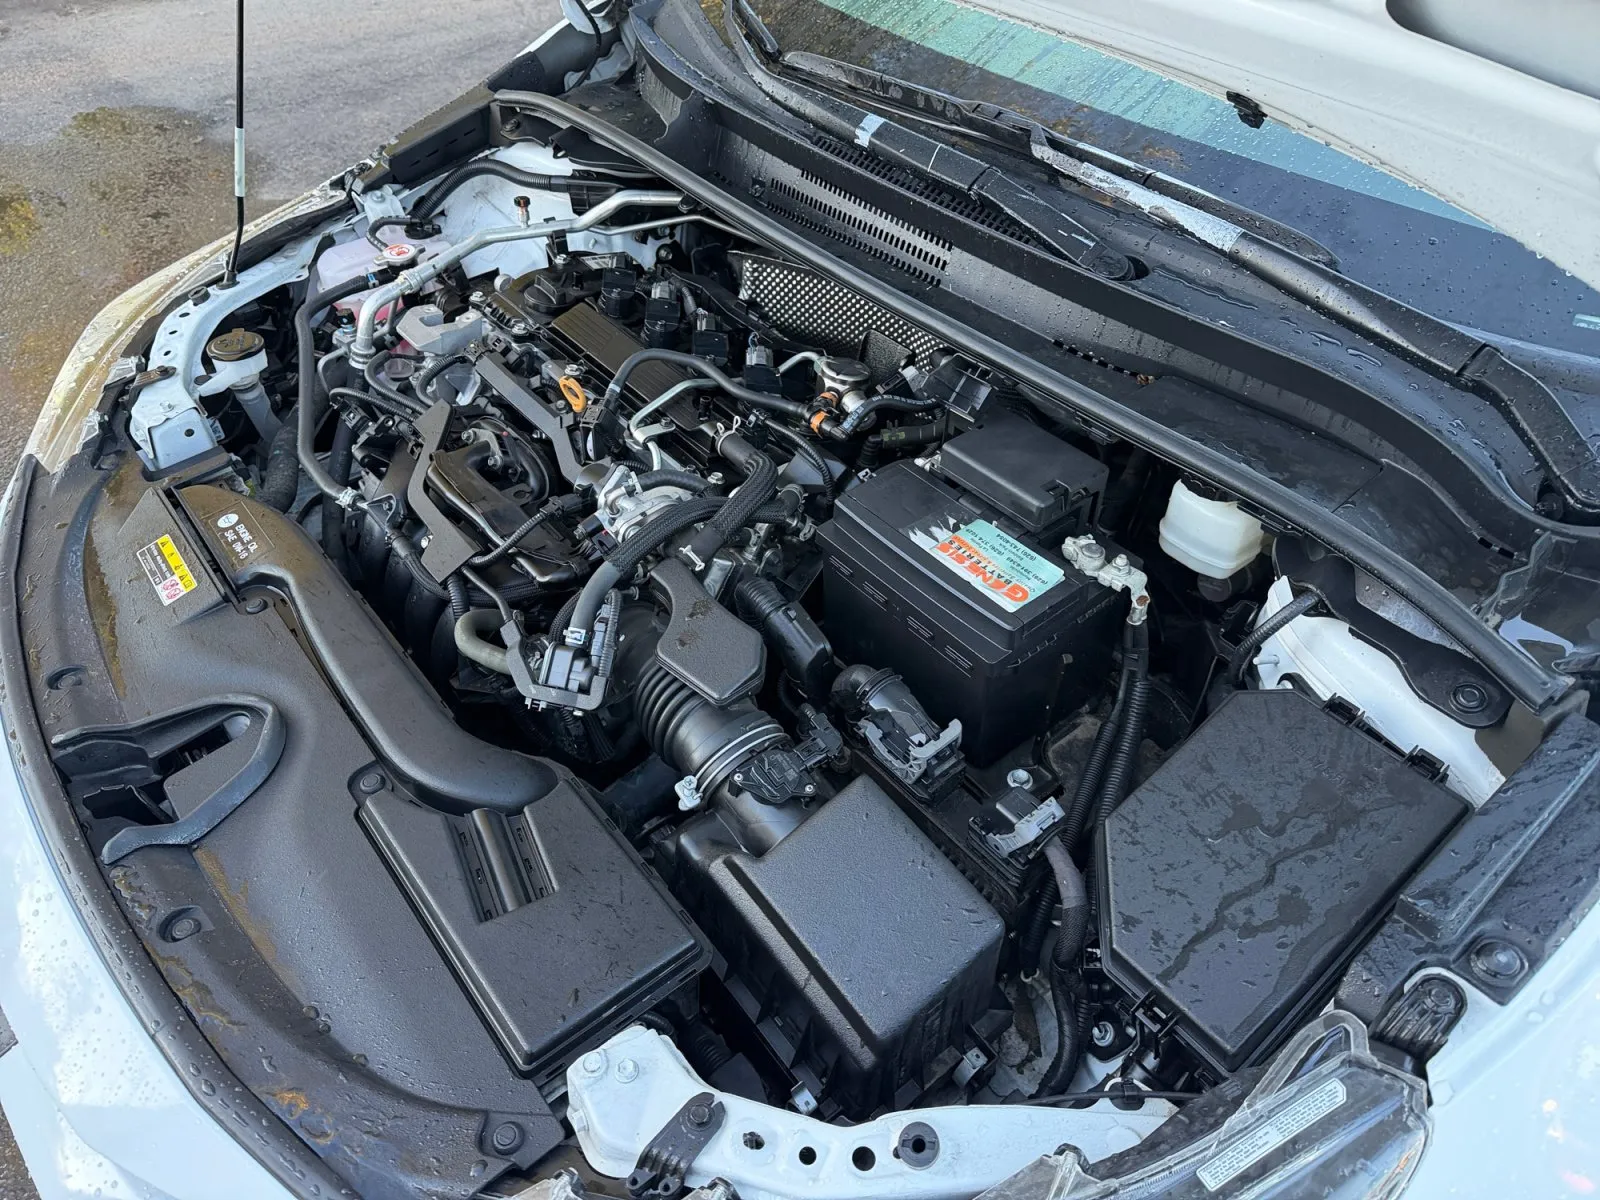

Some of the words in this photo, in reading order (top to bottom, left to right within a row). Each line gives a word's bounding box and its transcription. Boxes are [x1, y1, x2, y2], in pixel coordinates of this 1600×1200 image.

[224, 529, 238, 542] SAE
[232, 541, 249, 559] 0W-16
[948, 540, 1012, 585] BATTERIES
[936, 542, 1029, 602] GENESIS
